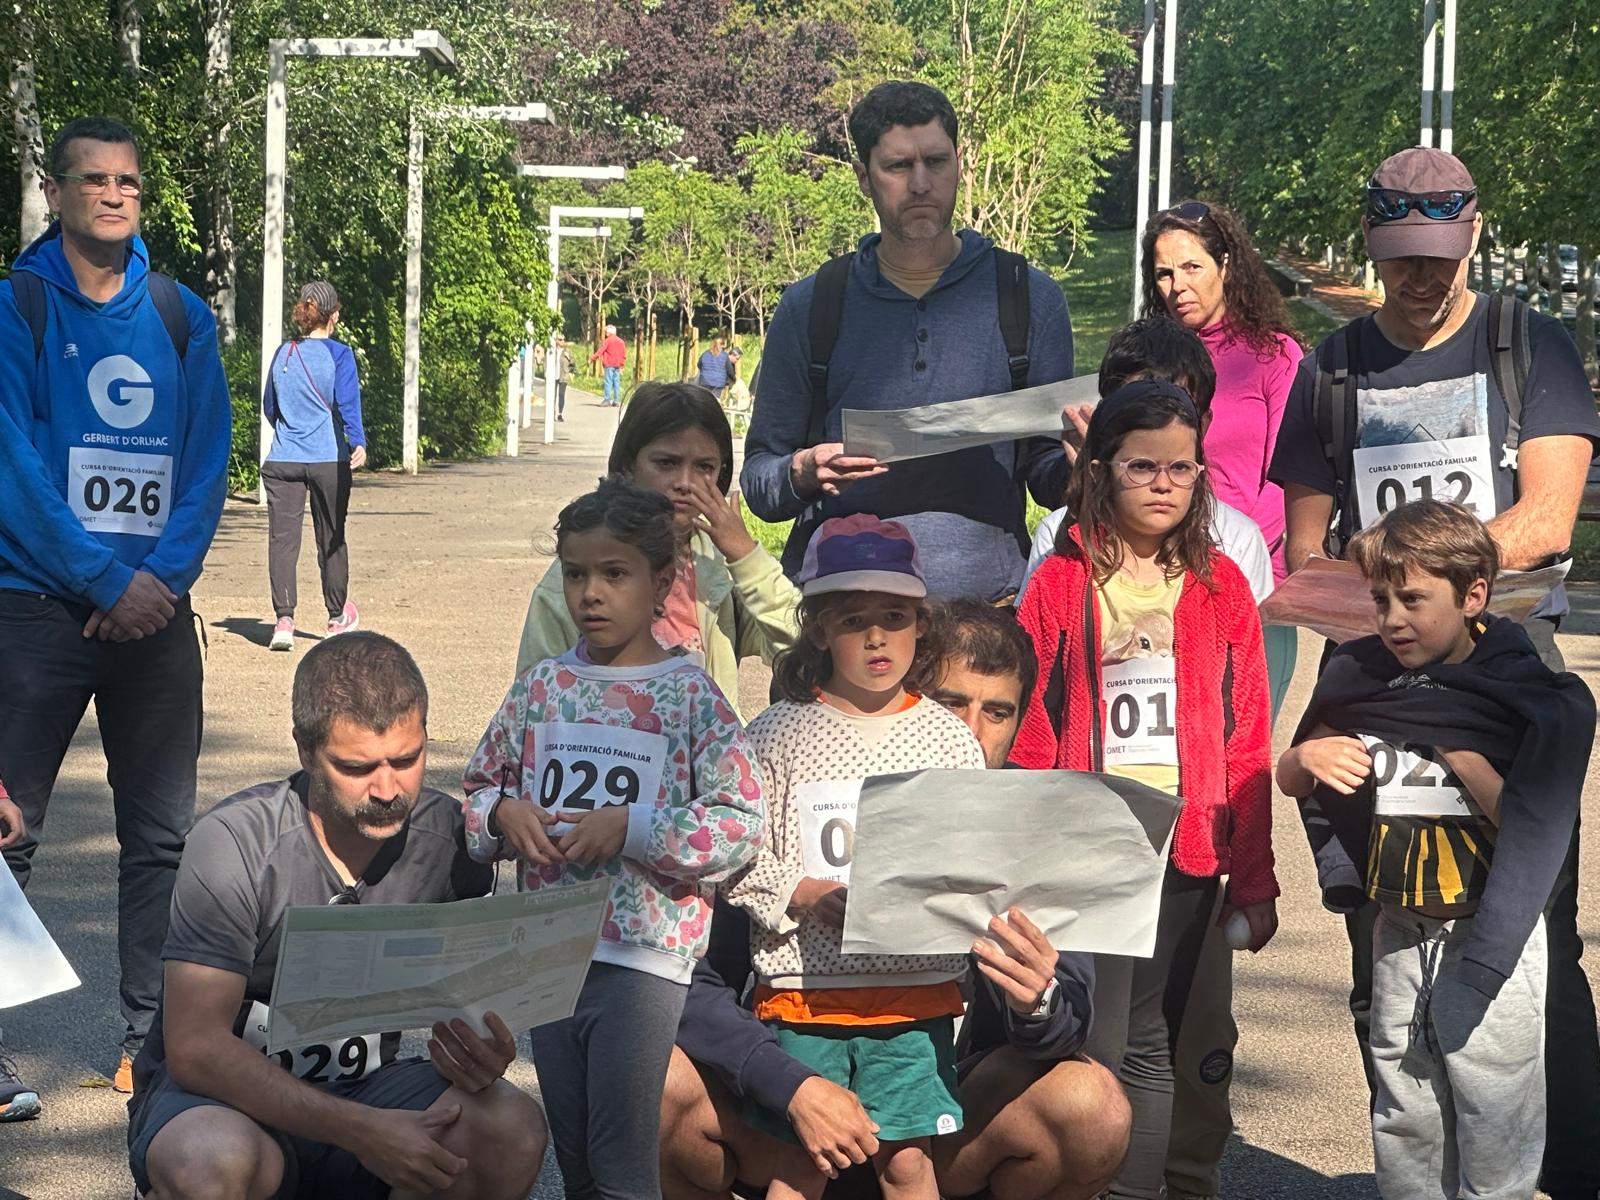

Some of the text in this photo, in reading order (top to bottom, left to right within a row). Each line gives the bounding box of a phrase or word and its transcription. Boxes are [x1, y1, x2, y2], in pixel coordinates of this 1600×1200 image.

[87, 354, 154, 429] G
[82, 433, 169, 446] GERBERT D'ORLHAC
[1393, 459, 1443, 471] D'ORIENTACIÓ
[1445, 456, 1477, 464] FAMILIAR
[83, 475, 161, 517] 026
[1376, 471, 1477, 515] 012
[559, 743, 612, 756] D'ORIENTACIÓ
[613, 749, 652, 764] FAMILIAR
[539, 758, 640, 811] 029
